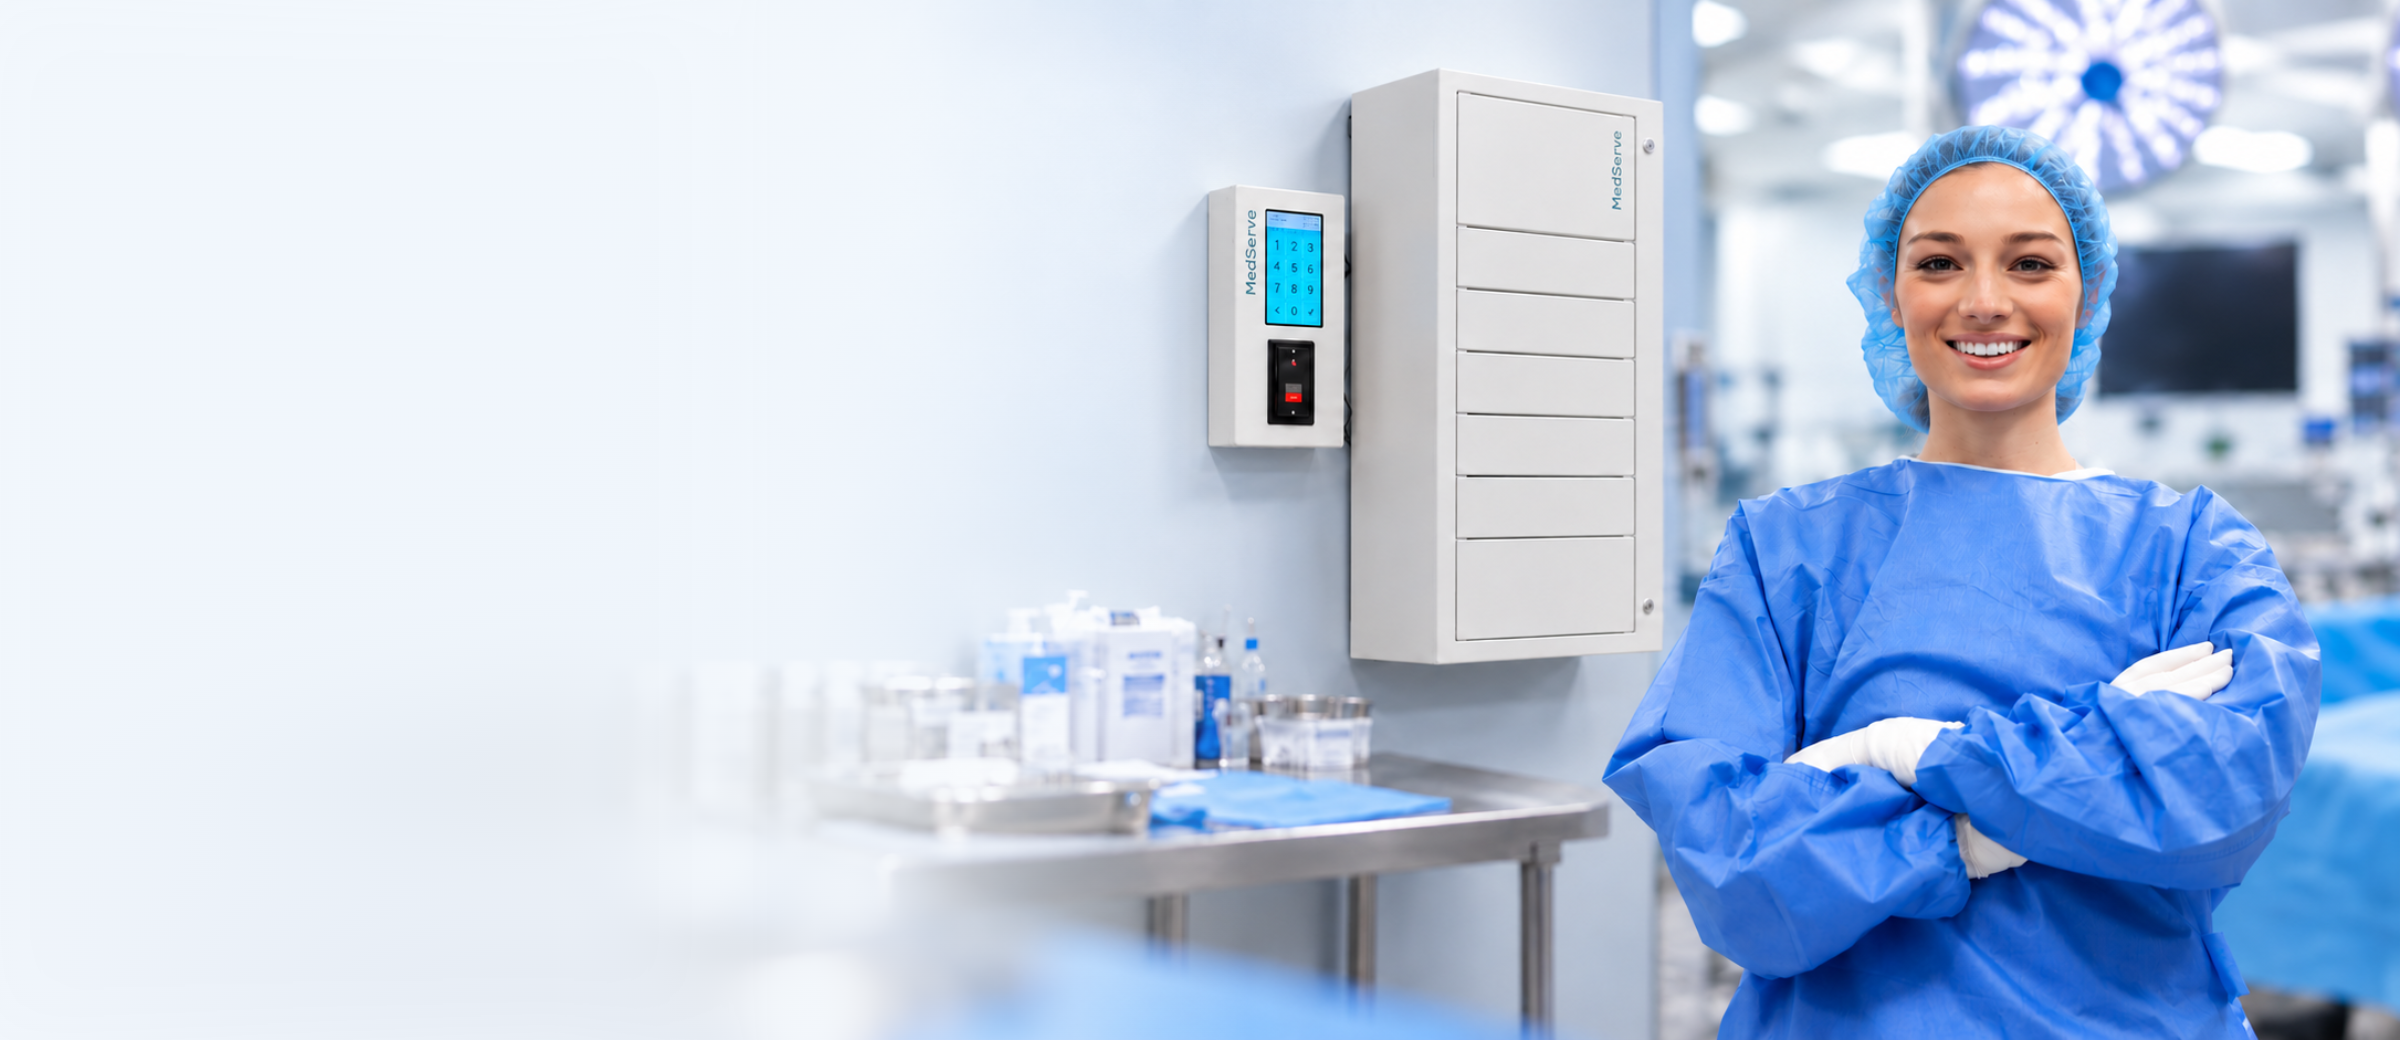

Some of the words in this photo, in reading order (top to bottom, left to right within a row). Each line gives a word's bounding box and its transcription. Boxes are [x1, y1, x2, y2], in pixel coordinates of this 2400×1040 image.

[1611, 130, 1622, 211] MedServe
[1245, 209, 1257, 296] MedServe
[1275, 239, 1279, 251] 1
[1290, 241, 1298, 252] 2
[1307, 242, 1314, 253] 3
[1273, 261, 1280, 271] 4
[1290, 262, 1298, 273] 5
[1307, 264, 1314, 274] 6
[1274, 282, 1281, 293] 7
[1290, 283, 1298, 294] 8
[1307, 284, 1314, 295] 9
[1290, 306, 1298, 316] 0
